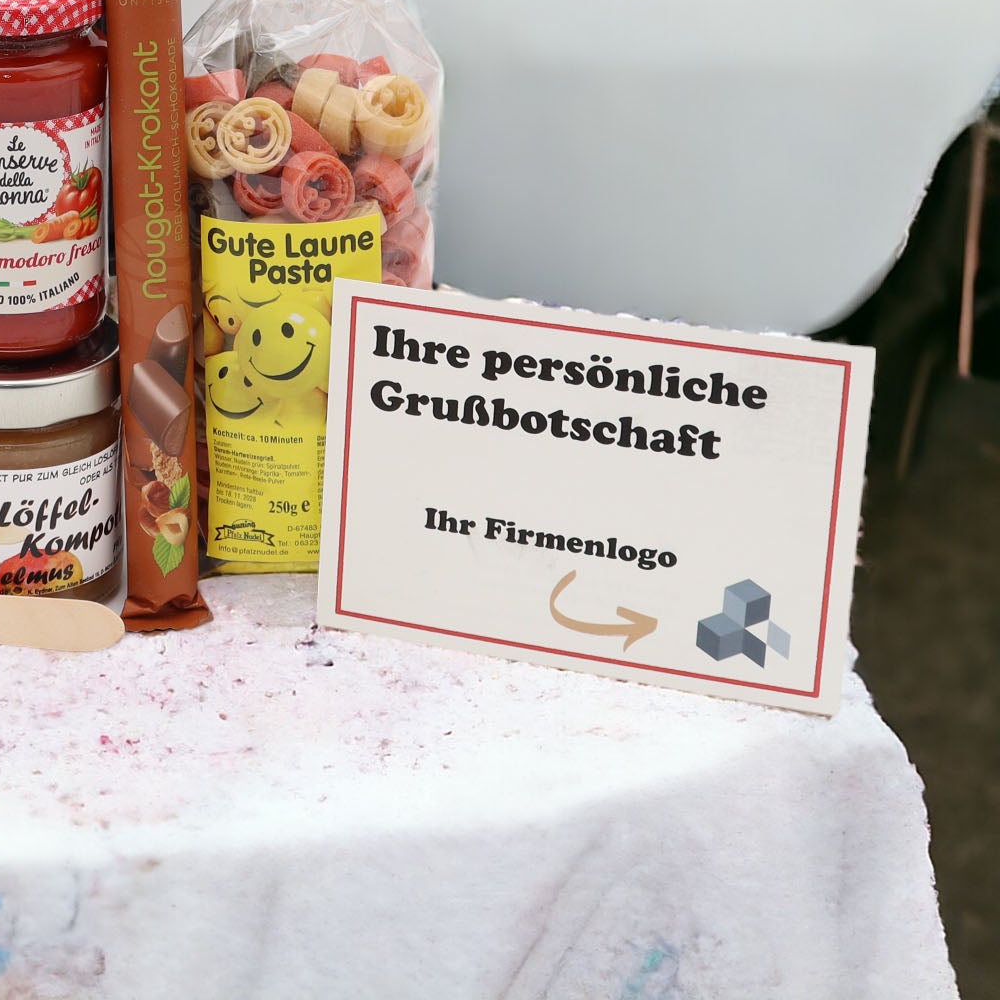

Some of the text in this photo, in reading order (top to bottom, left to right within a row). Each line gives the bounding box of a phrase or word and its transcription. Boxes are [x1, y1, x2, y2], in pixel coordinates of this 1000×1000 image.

[6, 135, 26, 152] Le
[0, 171, 34, 187] della
[207, 227, 374, 258] Gute Laune
[249, 259, 332, 285] Pasta
[7, 294, 36, 306] 100%
[39, 271, 80, 302] ITALIANO
[372, 324, 768, 411] Ihre persönliche
[369, 379, 722, 460] Grußbotschaft
[260, 435, 269, 443] 10
[270, 435, 304, 444] Minuten
[12, 473, 33, 483] PUR
[37, 470, 59, 481] ZUM
[62, 461, 92, 477] GLEICH
[80, 470, 101, 486] ODER
[269, 500, 298, 516] 250g
[424, 507, 678, 571] Ihr Firmenlogo
